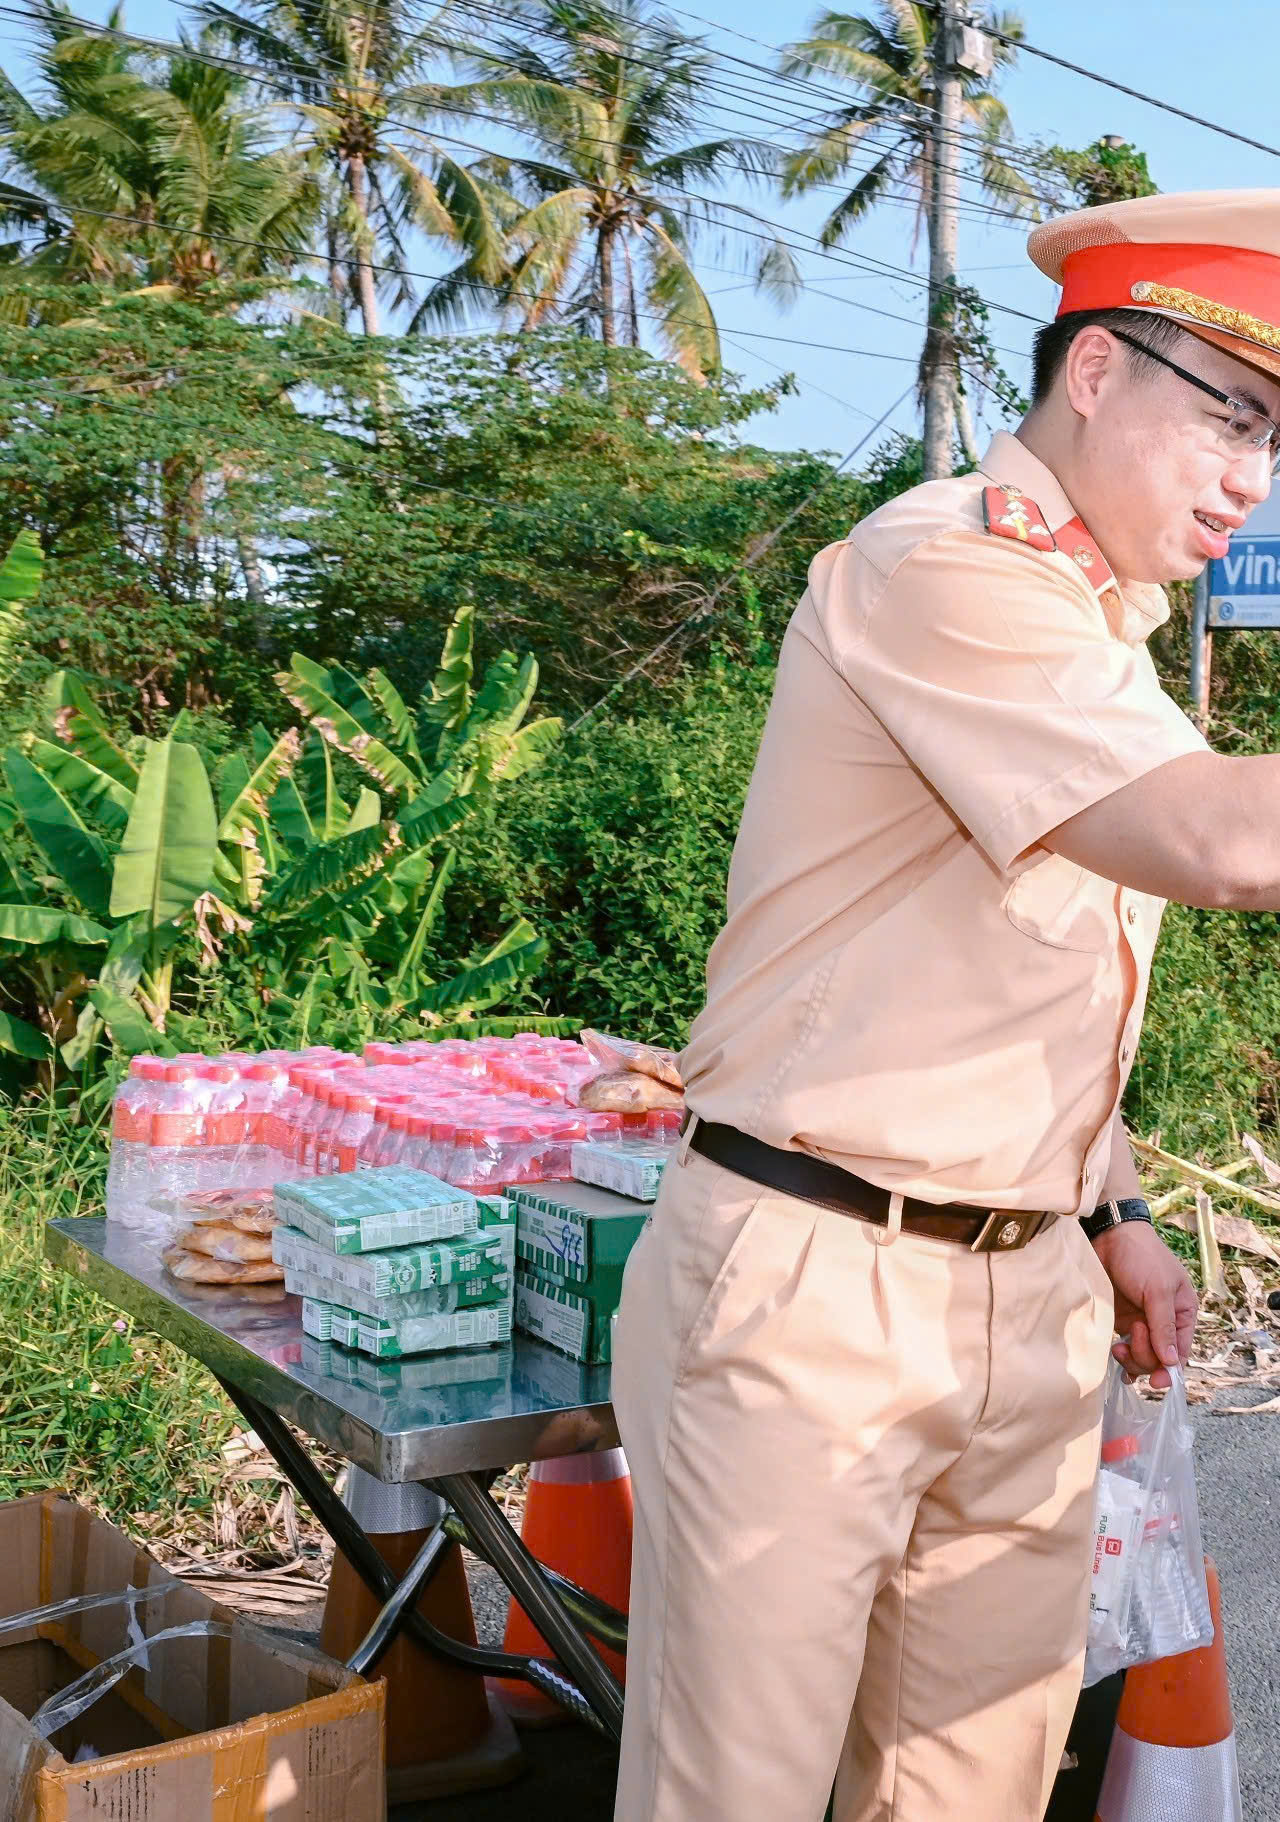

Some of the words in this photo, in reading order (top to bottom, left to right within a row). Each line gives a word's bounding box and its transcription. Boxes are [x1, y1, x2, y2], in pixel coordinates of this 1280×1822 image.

[1098, 1515, 1108, 1534] FUTA
[1096, 1535, 1105, 1552] Bus
[1092, 1552, 1103, 1575] Lines
